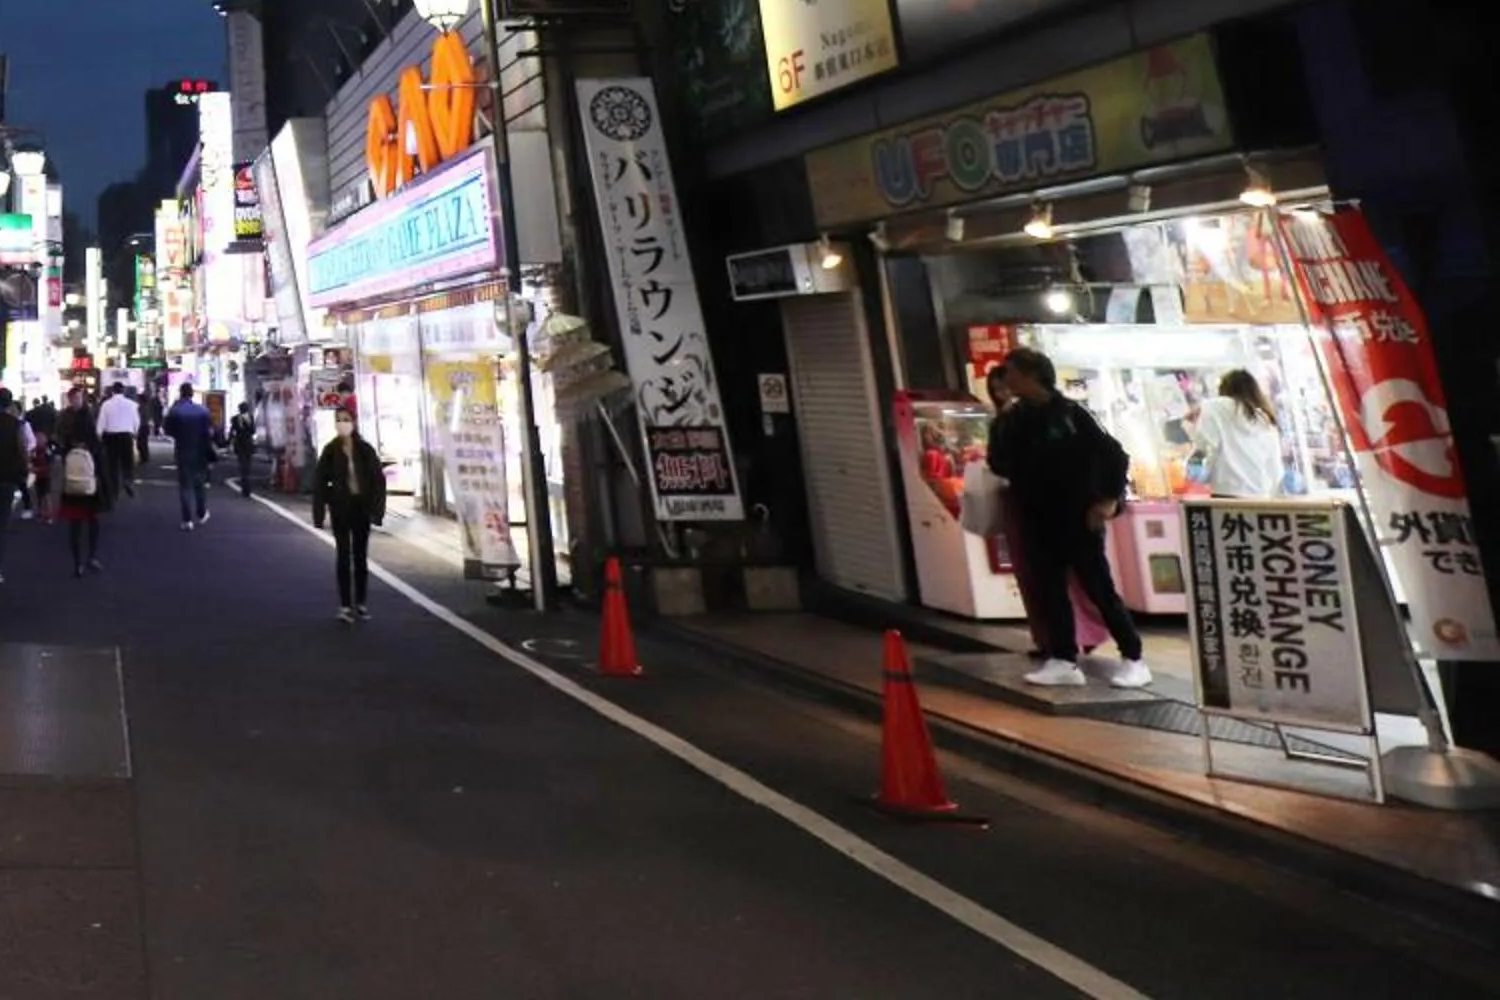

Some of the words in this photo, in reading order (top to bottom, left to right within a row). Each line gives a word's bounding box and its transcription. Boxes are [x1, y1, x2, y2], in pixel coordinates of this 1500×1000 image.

[779, 50, 807, 94] 6F
[872, 117, 992, 207] UFO
[614, 150, 694, 415] バリラウンジ
[1221, 513, 1266, 639] 外币兑换
[1257, 513, 1311, 694] EXCHANGE
[1295, 513, 1345, 633] MONEY
